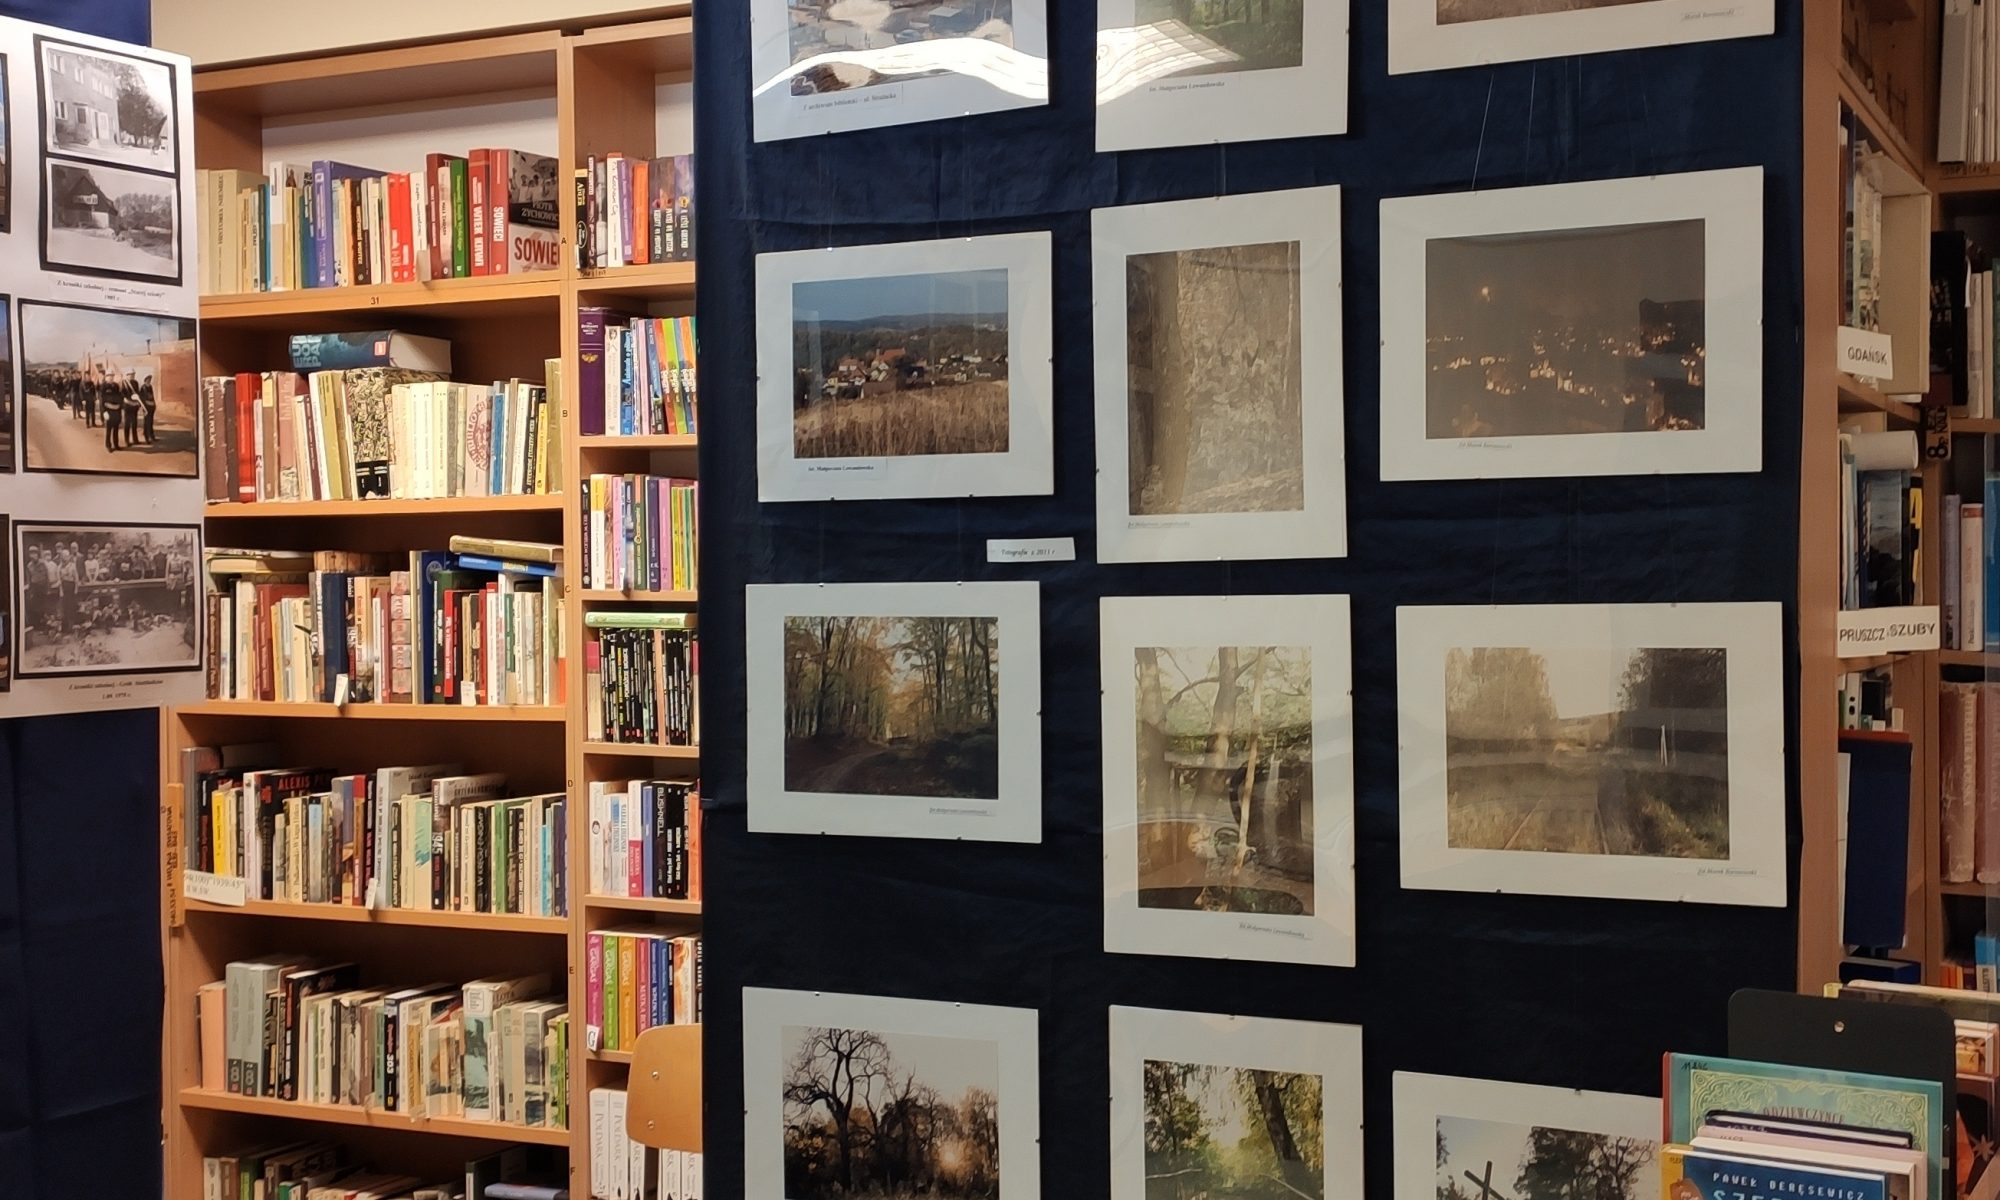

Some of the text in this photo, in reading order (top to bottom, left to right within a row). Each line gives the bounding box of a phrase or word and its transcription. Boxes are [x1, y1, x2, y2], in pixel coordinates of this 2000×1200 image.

[473, 206, 483, 234] WIEK
[493, 206, 504, 242] SOWIECI
[521, 207, 559, 222] ZYCHOWIC
[514, 237, 559, 265] SOWIE
[1848, 346, 1888, 365] GDAŃSK
[1839, 622, 1935, 642] PRUSZCZ SZUBY
[278, 776, 310, 791] ALEXIS
[657, 787, 665, 837] BUSHNELL
[1713, 1172, 1757, 1187] PAWEŁ
[1769, 1179, 1864, 1200] BERĘSEWICZ
